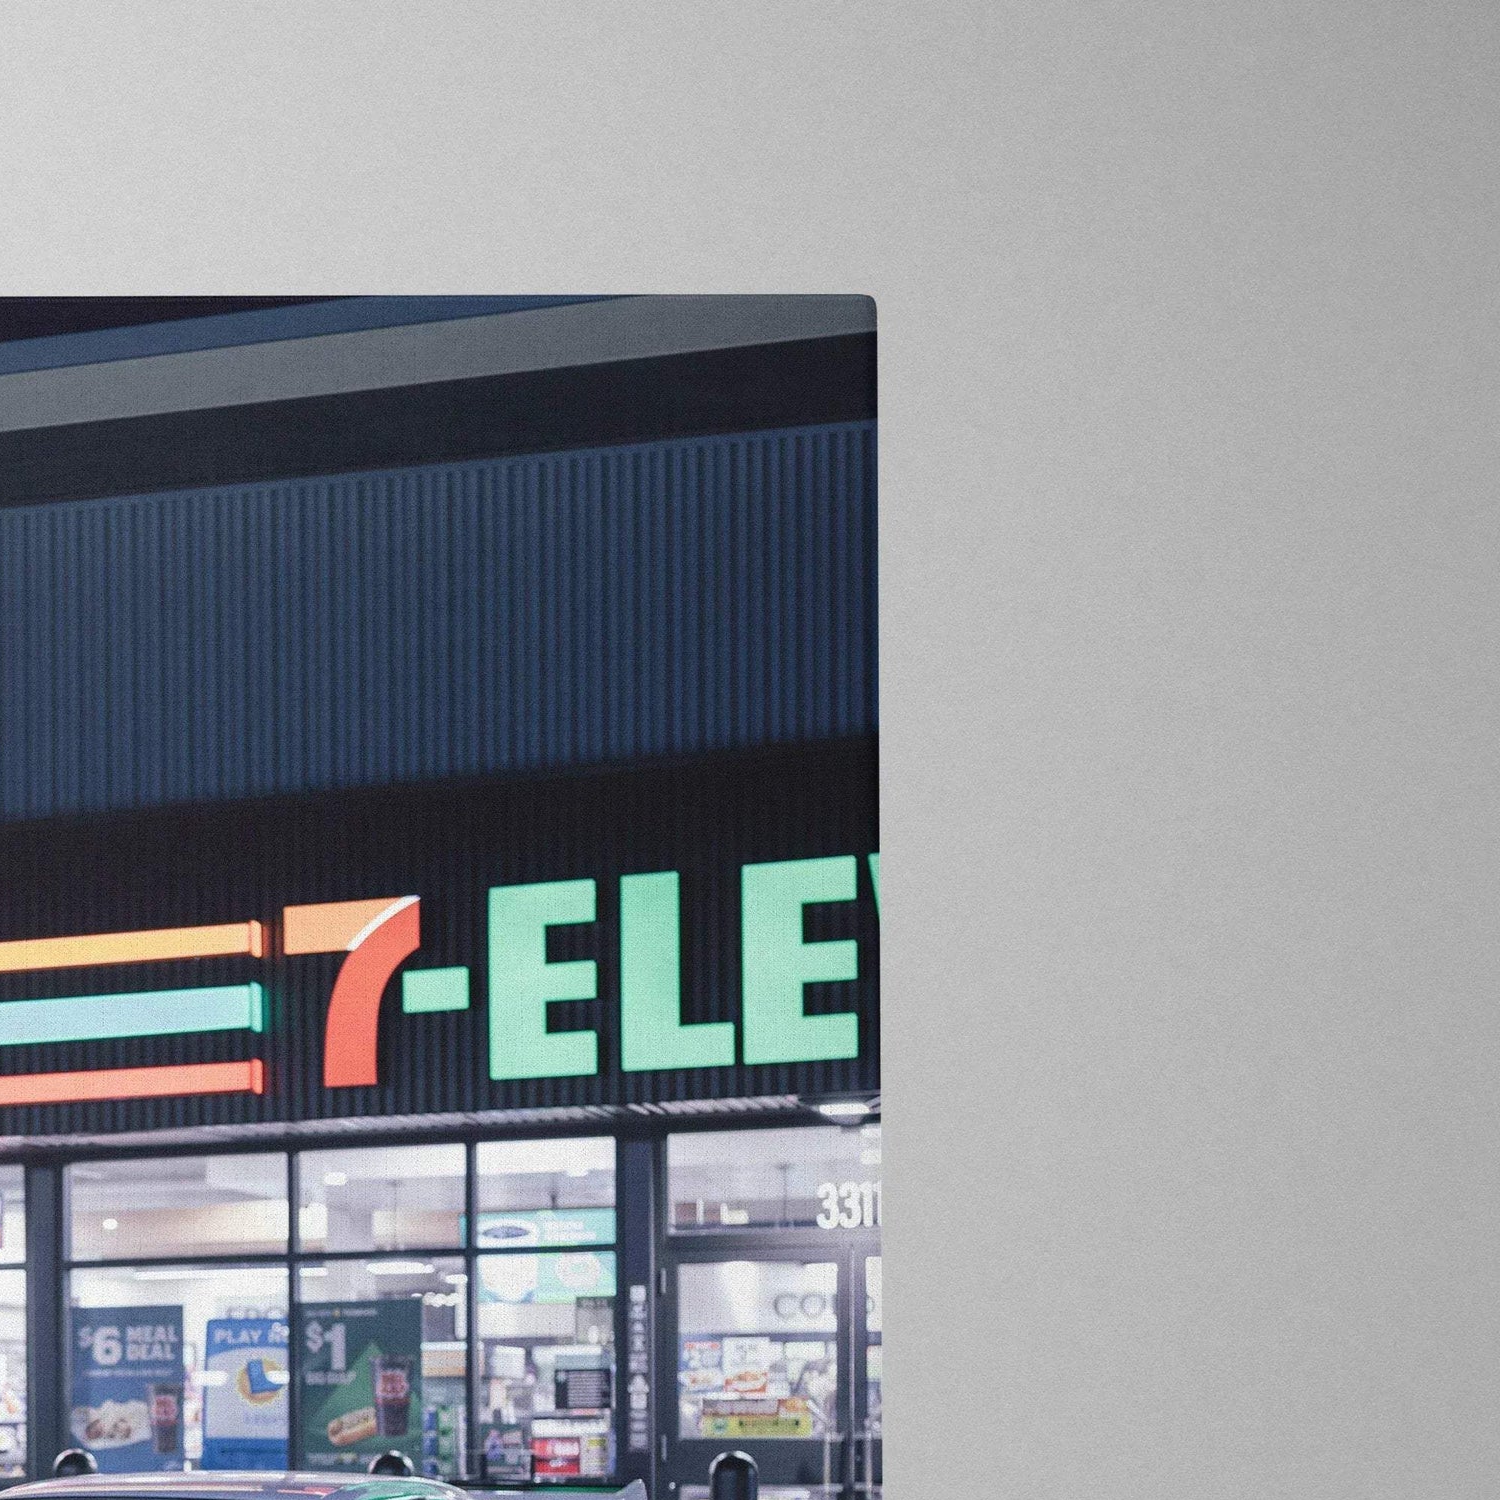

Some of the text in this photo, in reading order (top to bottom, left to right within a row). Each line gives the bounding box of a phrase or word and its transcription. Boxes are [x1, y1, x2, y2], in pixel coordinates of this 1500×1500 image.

[283, 852, 881, 1087] 7-ELE
[78, 1325, 178, 1366] $6 MEAL
[125, 1342, 176, 1362] DEAL
[213, 1329, 262, 1345] PLAY
[305, 1320, 346, 1371] $1
